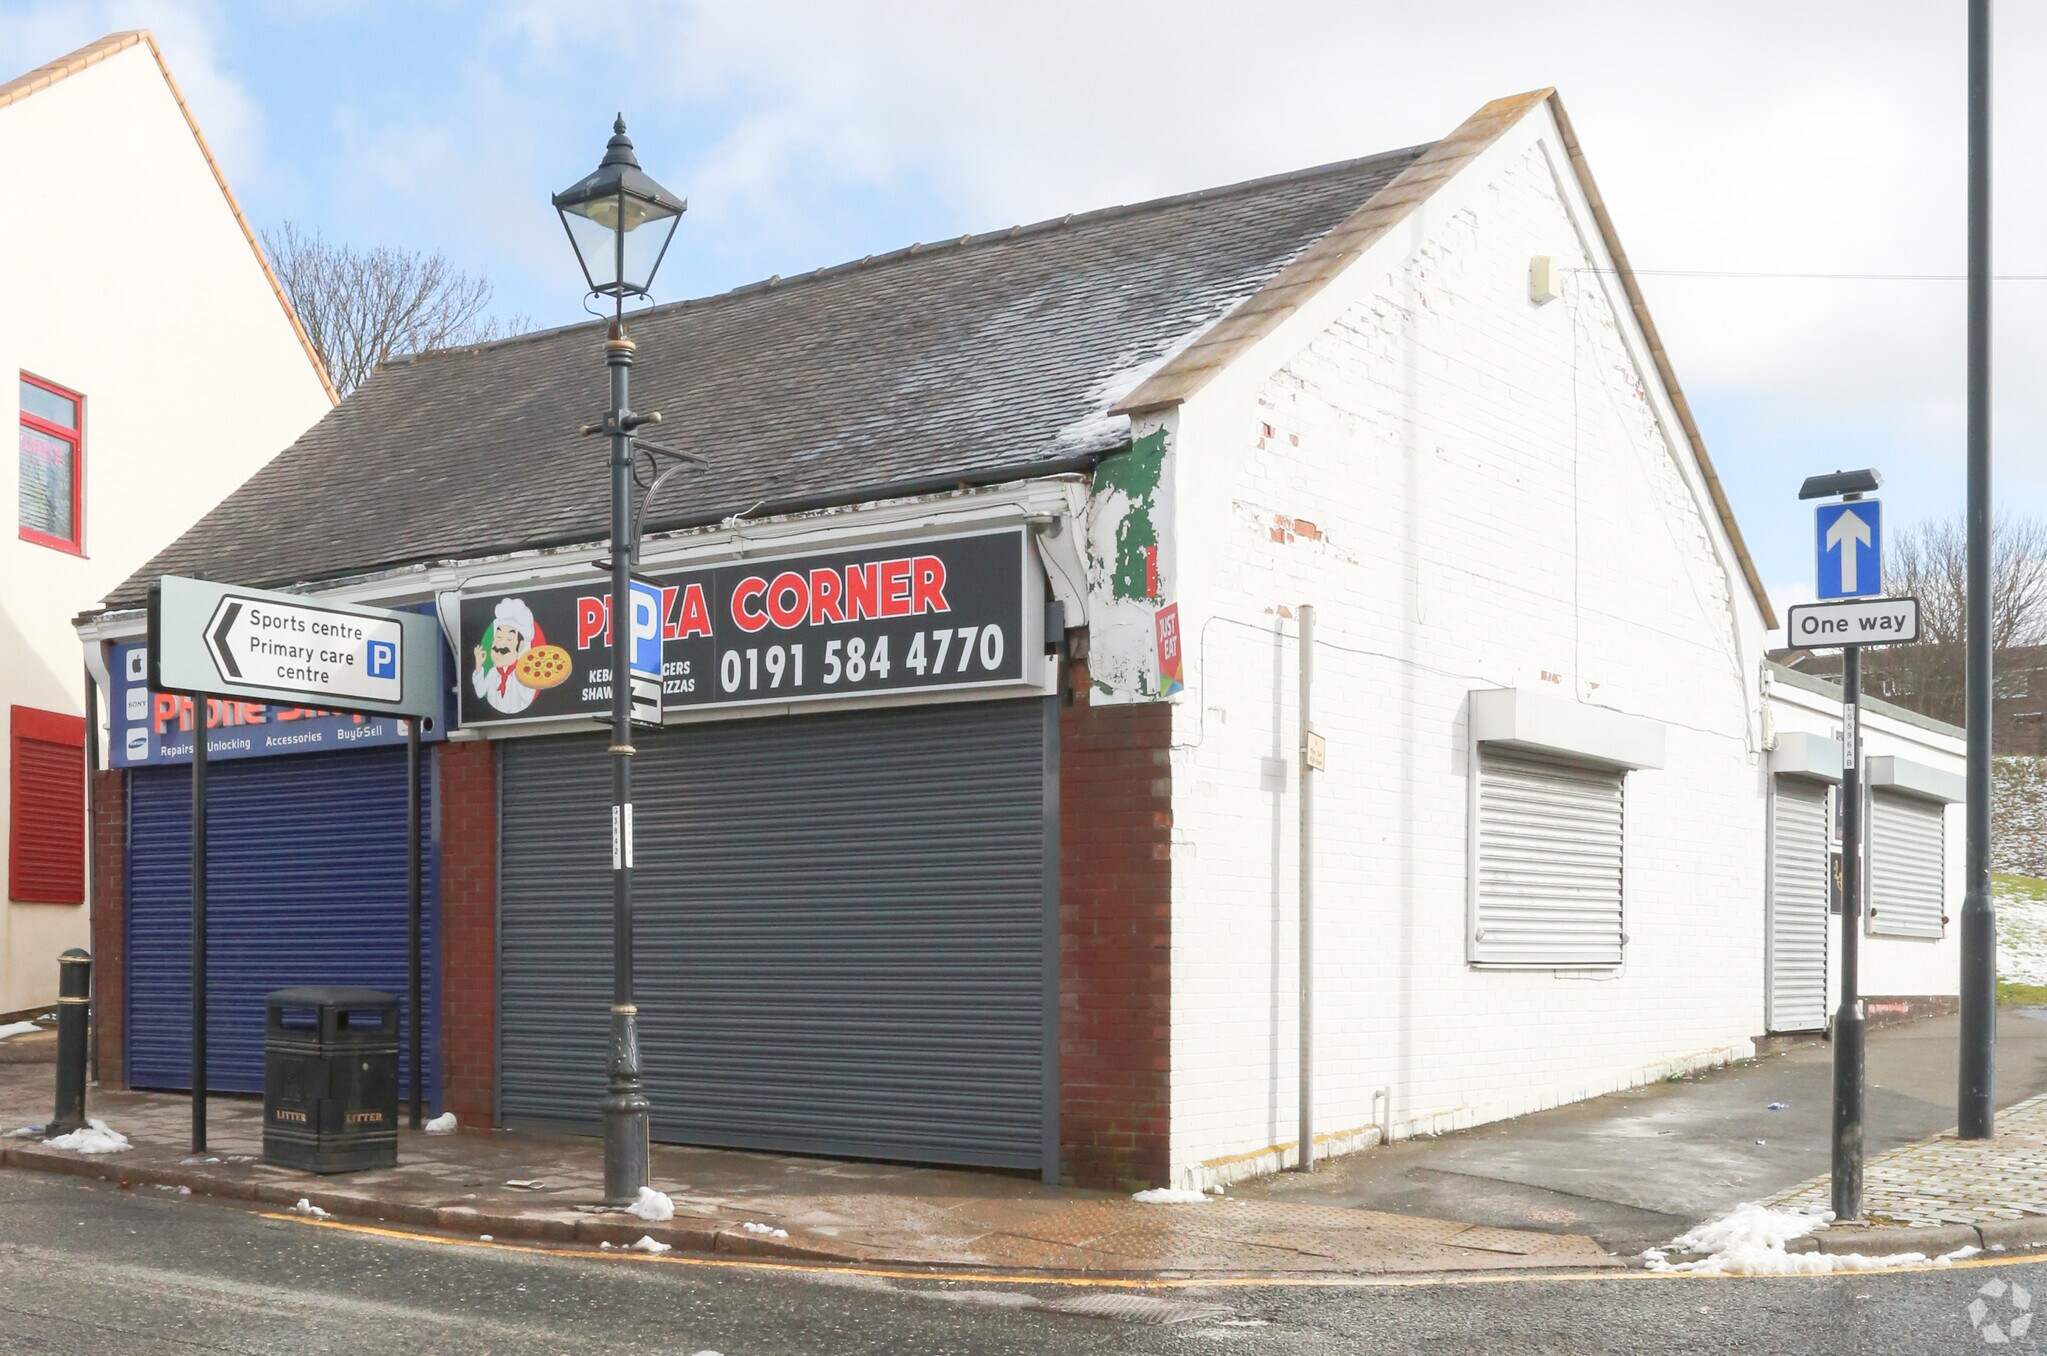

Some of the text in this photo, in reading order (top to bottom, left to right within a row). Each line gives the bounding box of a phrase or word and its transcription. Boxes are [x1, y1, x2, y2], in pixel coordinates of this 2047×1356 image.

[731, 555, 951, 633] CORNER
[250, 609, 363, 640] Sports centre
[630, 589, 657, 664] P
[1160, 612, 1175, 643] JUST
[1801, 614, 1907, 635] One way
[250, 637, 354, 666] Primary care
[373, 644, 392, 675] P
[720, 623, 1004, 693] 0191 584 4770
[1164, 635, 1177, 661] EAT
[277, 665, 330, 684] centre
[663, 678, 695, 694] IZZAS
[128, 700, 147, 708] SONY
[161, 725, 383, 757] Repairs Unlocking Accessories Buy&Sell
[276, 1109, 307, 1122] LITTER
[345, 1112, 383, 1123] LITTER
